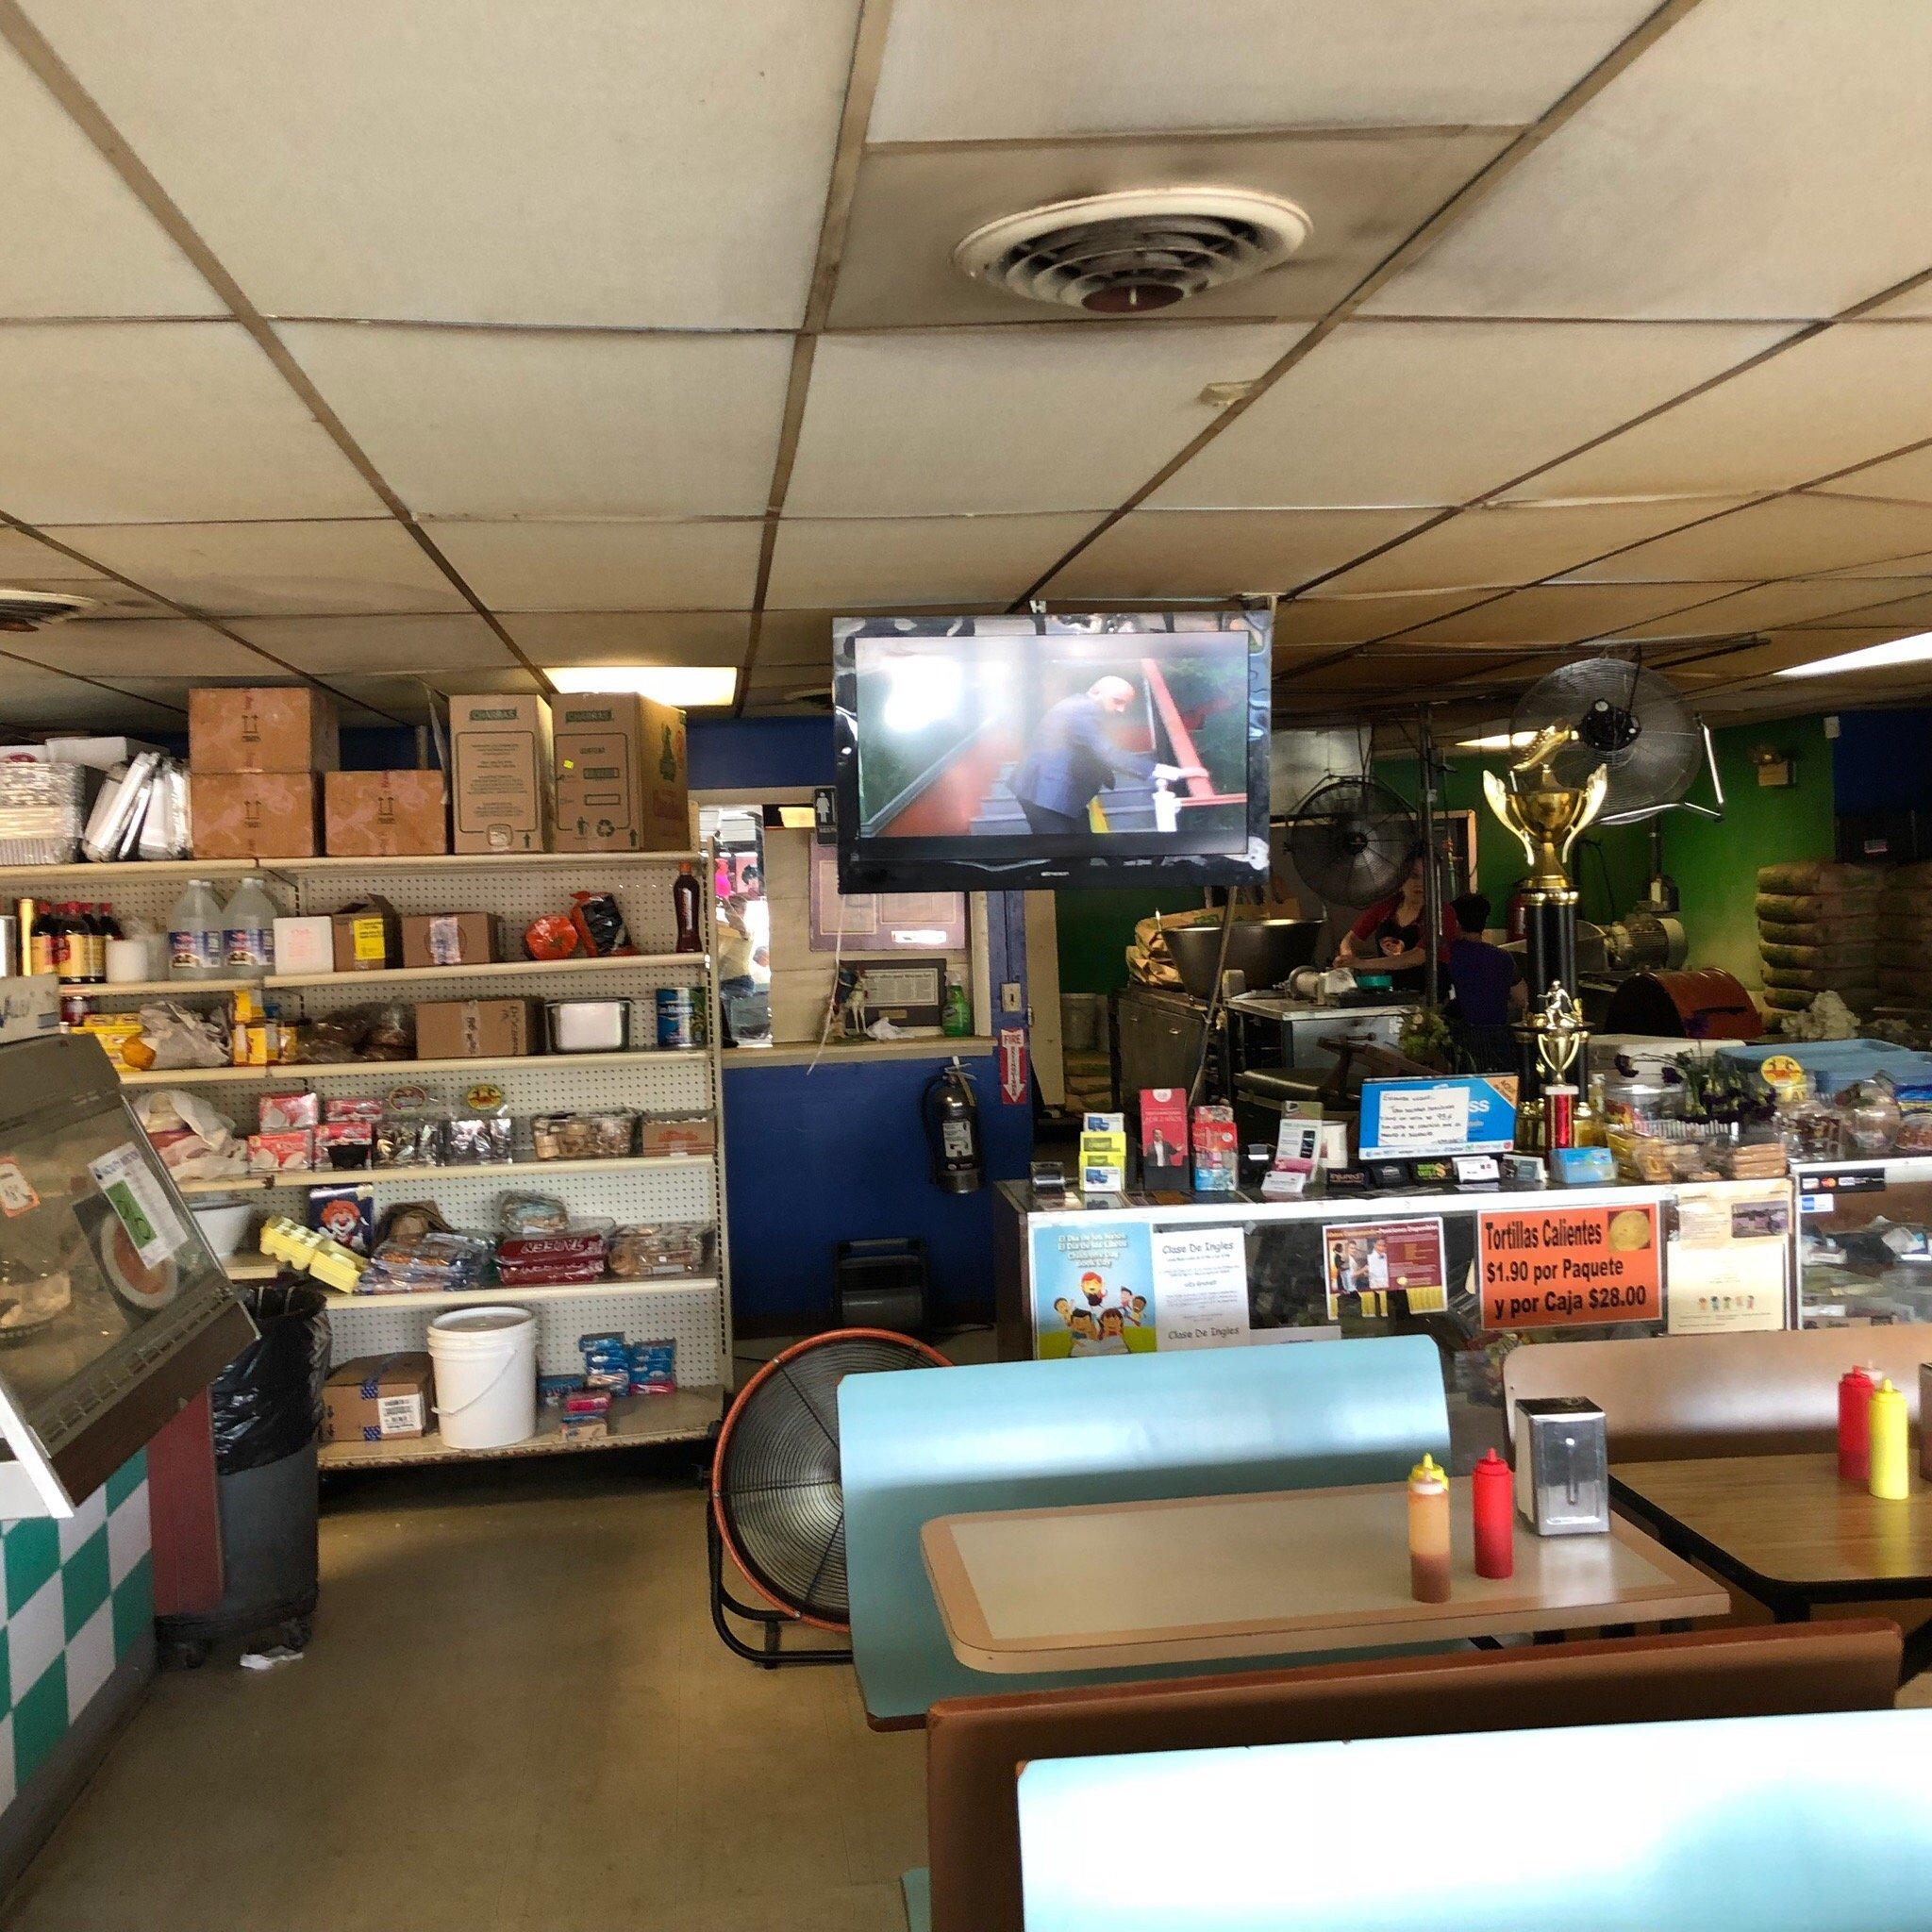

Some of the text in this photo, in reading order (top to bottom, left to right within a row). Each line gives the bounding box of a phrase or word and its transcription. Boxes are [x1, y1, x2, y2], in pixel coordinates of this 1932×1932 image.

[1004, 1034, 1022, 1044] FIRE
[1486, 1218, 1602, 1250] Tortillas Calientes
[1162, 1241, 1234, 1255] Clase De Ingles
[1487, 1257, 1624, 1286] $1.90 por Paquete
[1494, 1285, 1647, 1320] y por Caja $28.00
[1168, 1326, 1240, 1340] Clase De Ingles
